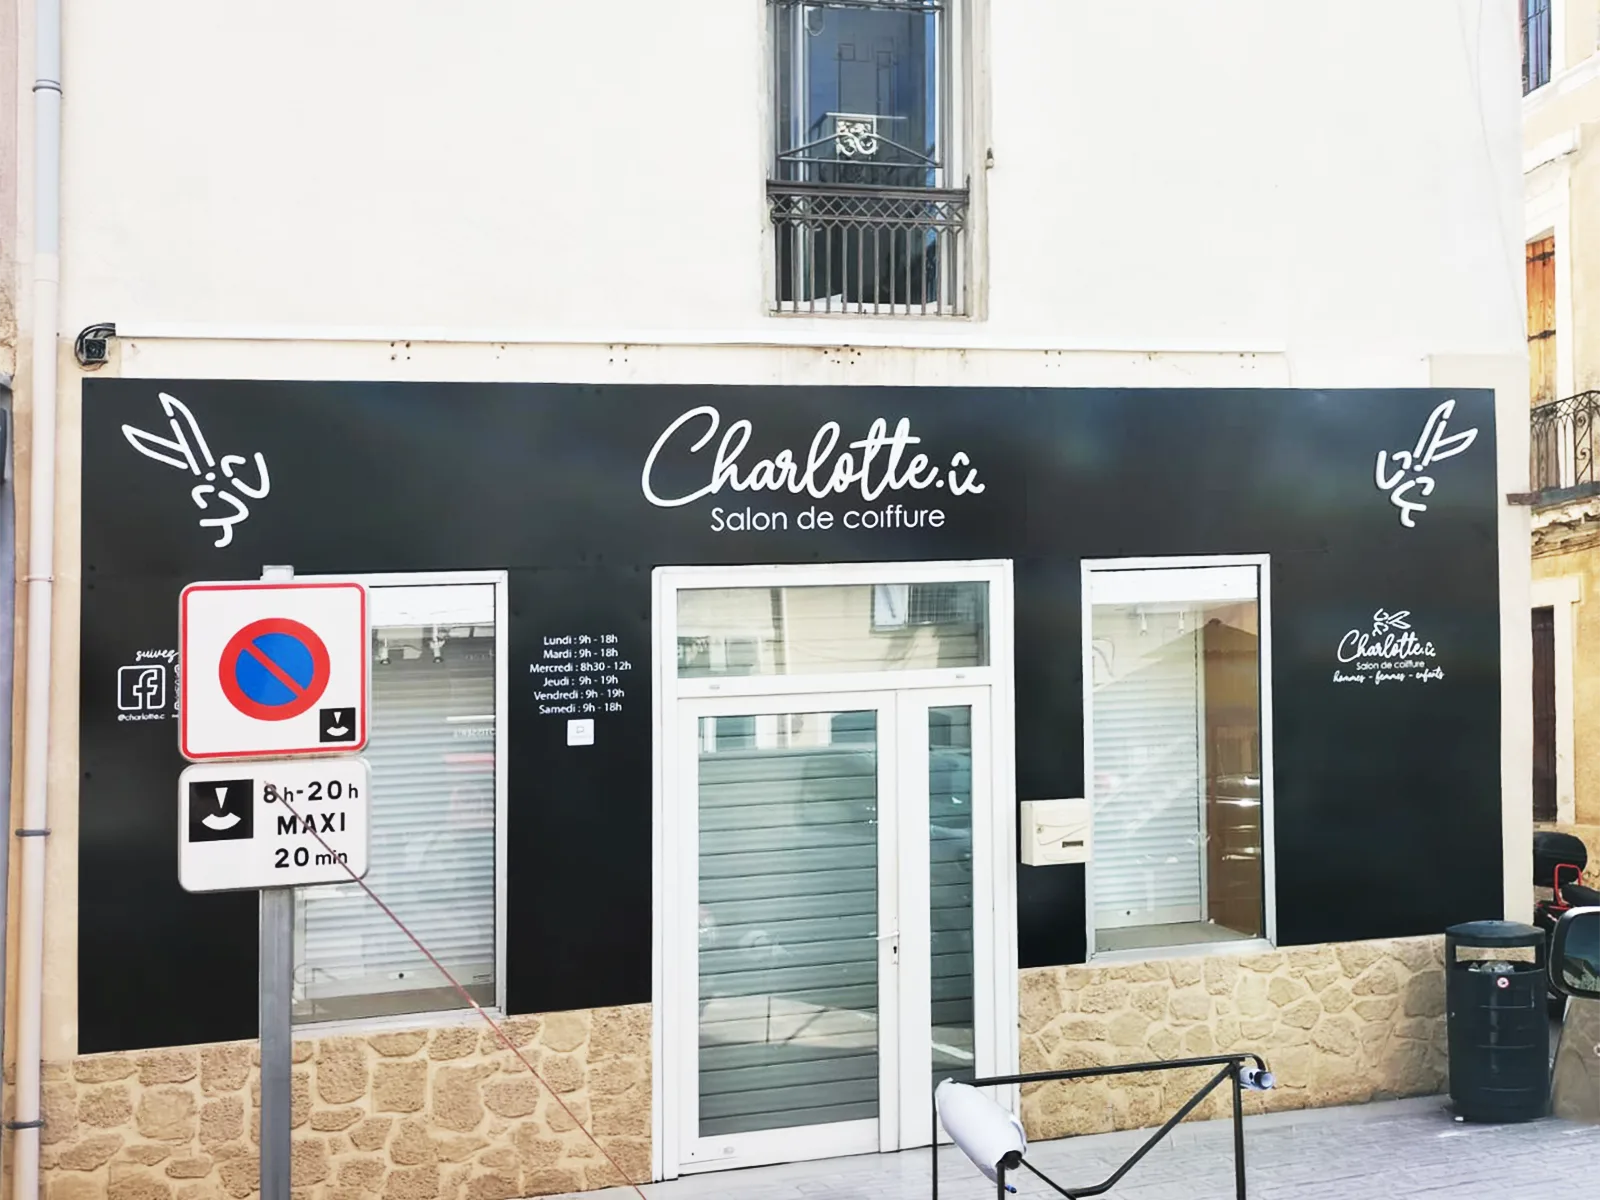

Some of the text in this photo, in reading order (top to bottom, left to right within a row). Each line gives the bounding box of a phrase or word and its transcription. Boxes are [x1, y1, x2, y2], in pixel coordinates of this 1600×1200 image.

[710, 504, 946, 532] Salon de coiffure
[543, 636, 572, 645] Lundi
[579, 635, 591, 644] 9h
[601, 634, 618, 643] 18h
[543, 649, 572, 659] Mardi
[579, 649, 591, 658] 9h
[601, 648, 618, 657] 18h
[530, 663, 573, 673] Mercredi
[580, 662, 605, 671] 8h30
[614, 661, 631, 670] 12h
[1356, 662, 1379, 670] Salon
[1380, 661, 1392, 669] de
[543, 677, 569, 687] Jeudi
[579, 676, 591, 685] 9h
[601, 675, 618, 684] 19h
[534, 690, 578, 701] Vendredi
[585, 690, 598, 698] 9h
[607, 689, 625, 698] 19h
[539, 704, 575, 714] Samedi
[583, 703, 595, 712] 9h
[605, 702, 622, 711] 18h
[277, 812, 346, 836] MAXI
[274, 847, 309, 868] 20
